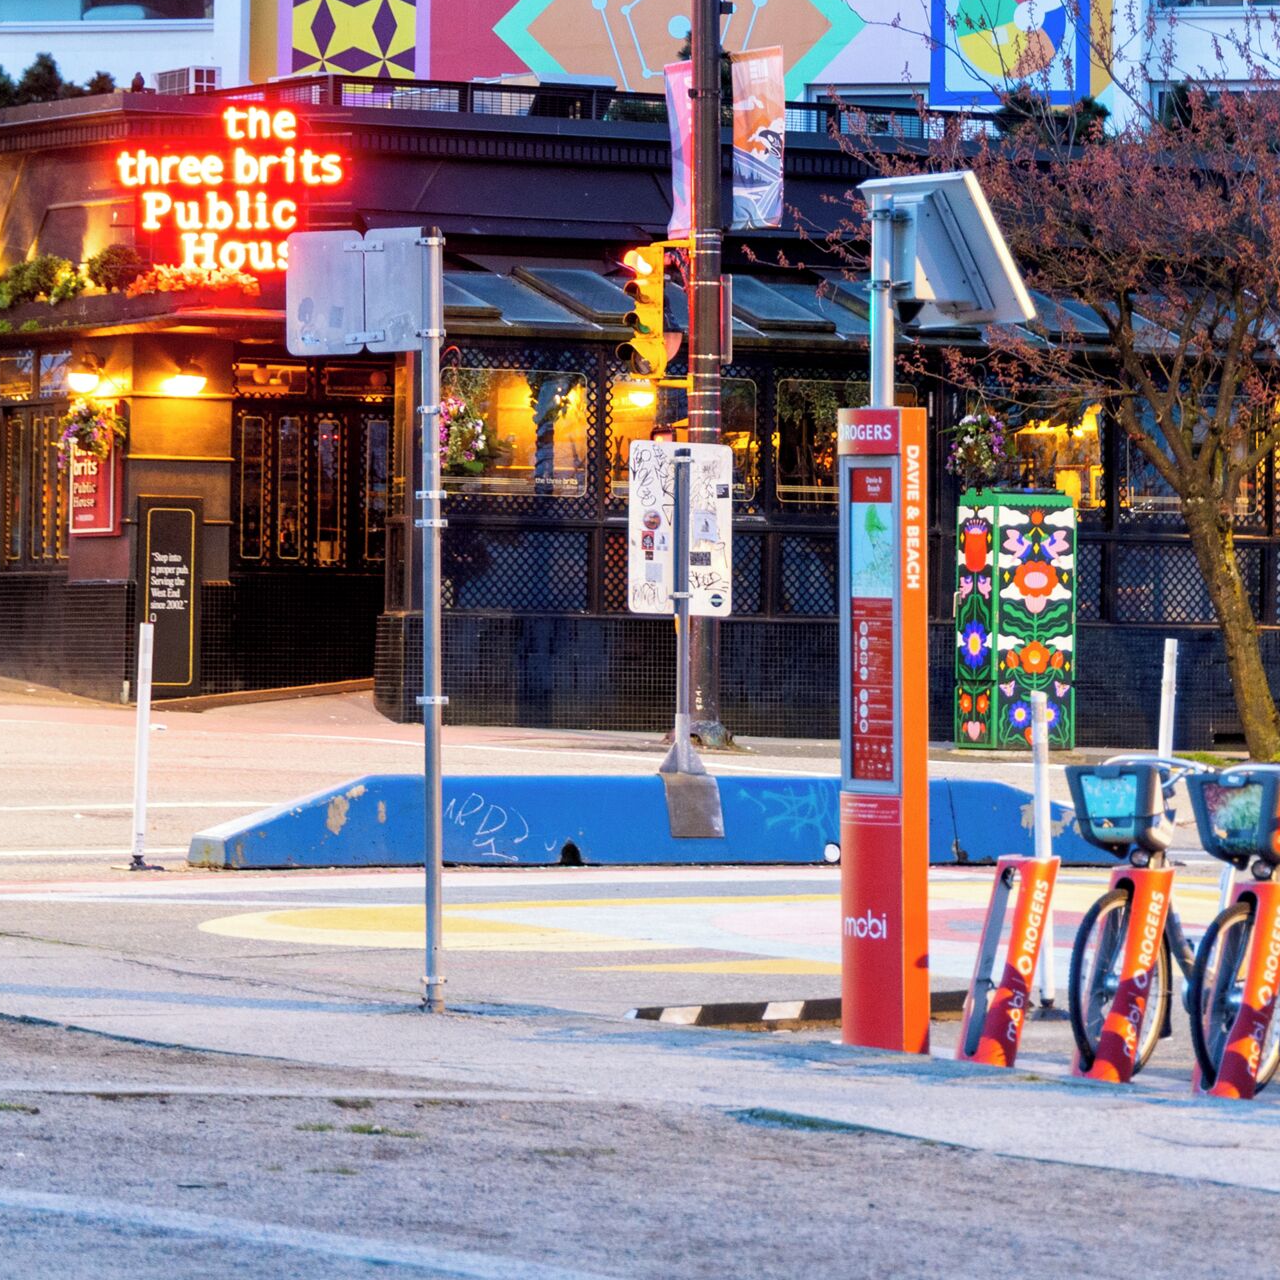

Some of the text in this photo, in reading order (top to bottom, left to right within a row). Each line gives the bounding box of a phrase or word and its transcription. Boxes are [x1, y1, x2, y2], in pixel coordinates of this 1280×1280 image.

[223, 106, 297, 140] the
[117, 146, 343, 186] three brits
[142, 190, 297, 231] Public
[180, 232, 289, 271] Hous
[845, 423, 893, 441] ROGERS
[73, 458, 98, 476] brits
[73, 482, 96, 494] Public
[73, 496, 95, 508] House
[906, 444, 920, 590] DAVIE & BEACH
[169, 553, 182, 563] into
[156, 567, 176, 576] proper
[150, 576, 185, 588] Serving the
[151, 588, 180, 598] West End
[150, 601, 166, 610] since
[844, 908, 887, 939] mobi
[1138, 891, 1165, 967] ROGERS
[1007, 879, 1049, 1042] mobi ROGERS
